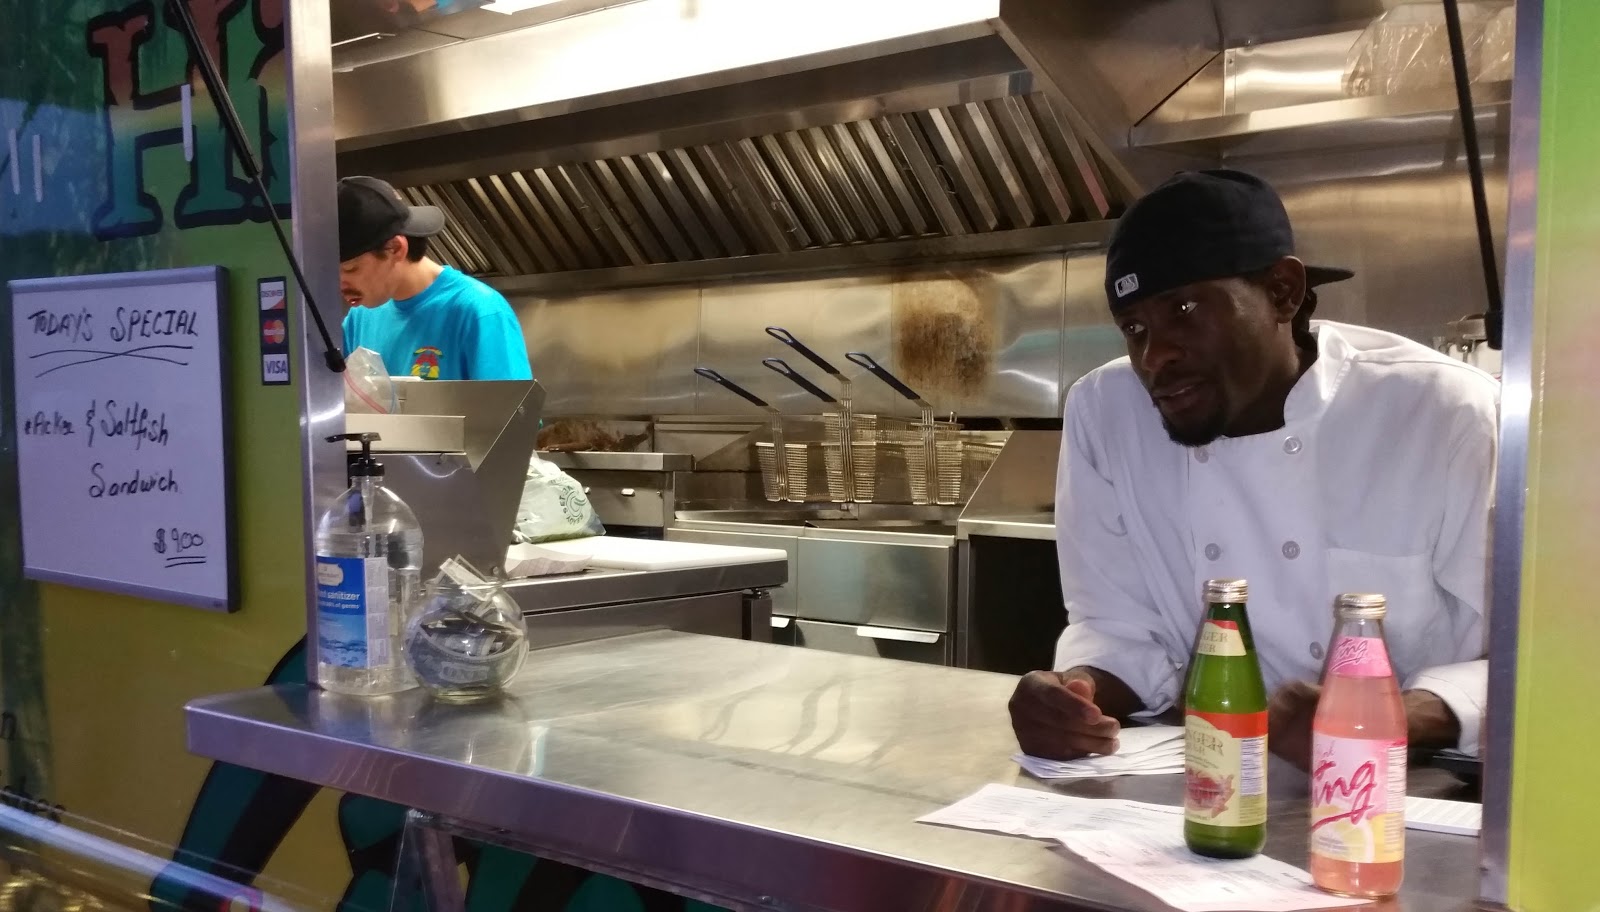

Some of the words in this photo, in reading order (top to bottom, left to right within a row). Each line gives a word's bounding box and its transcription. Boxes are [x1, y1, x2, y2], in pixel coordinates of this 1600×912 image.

[28, 308, 94, 343] TODAY'S
[110, 306, 198, 342] SPECIAL
[266, 361, 288, 374] VISA
[89, 462, 178, 498] Sandwich
[327, 590, 360, 601] sanitizer
